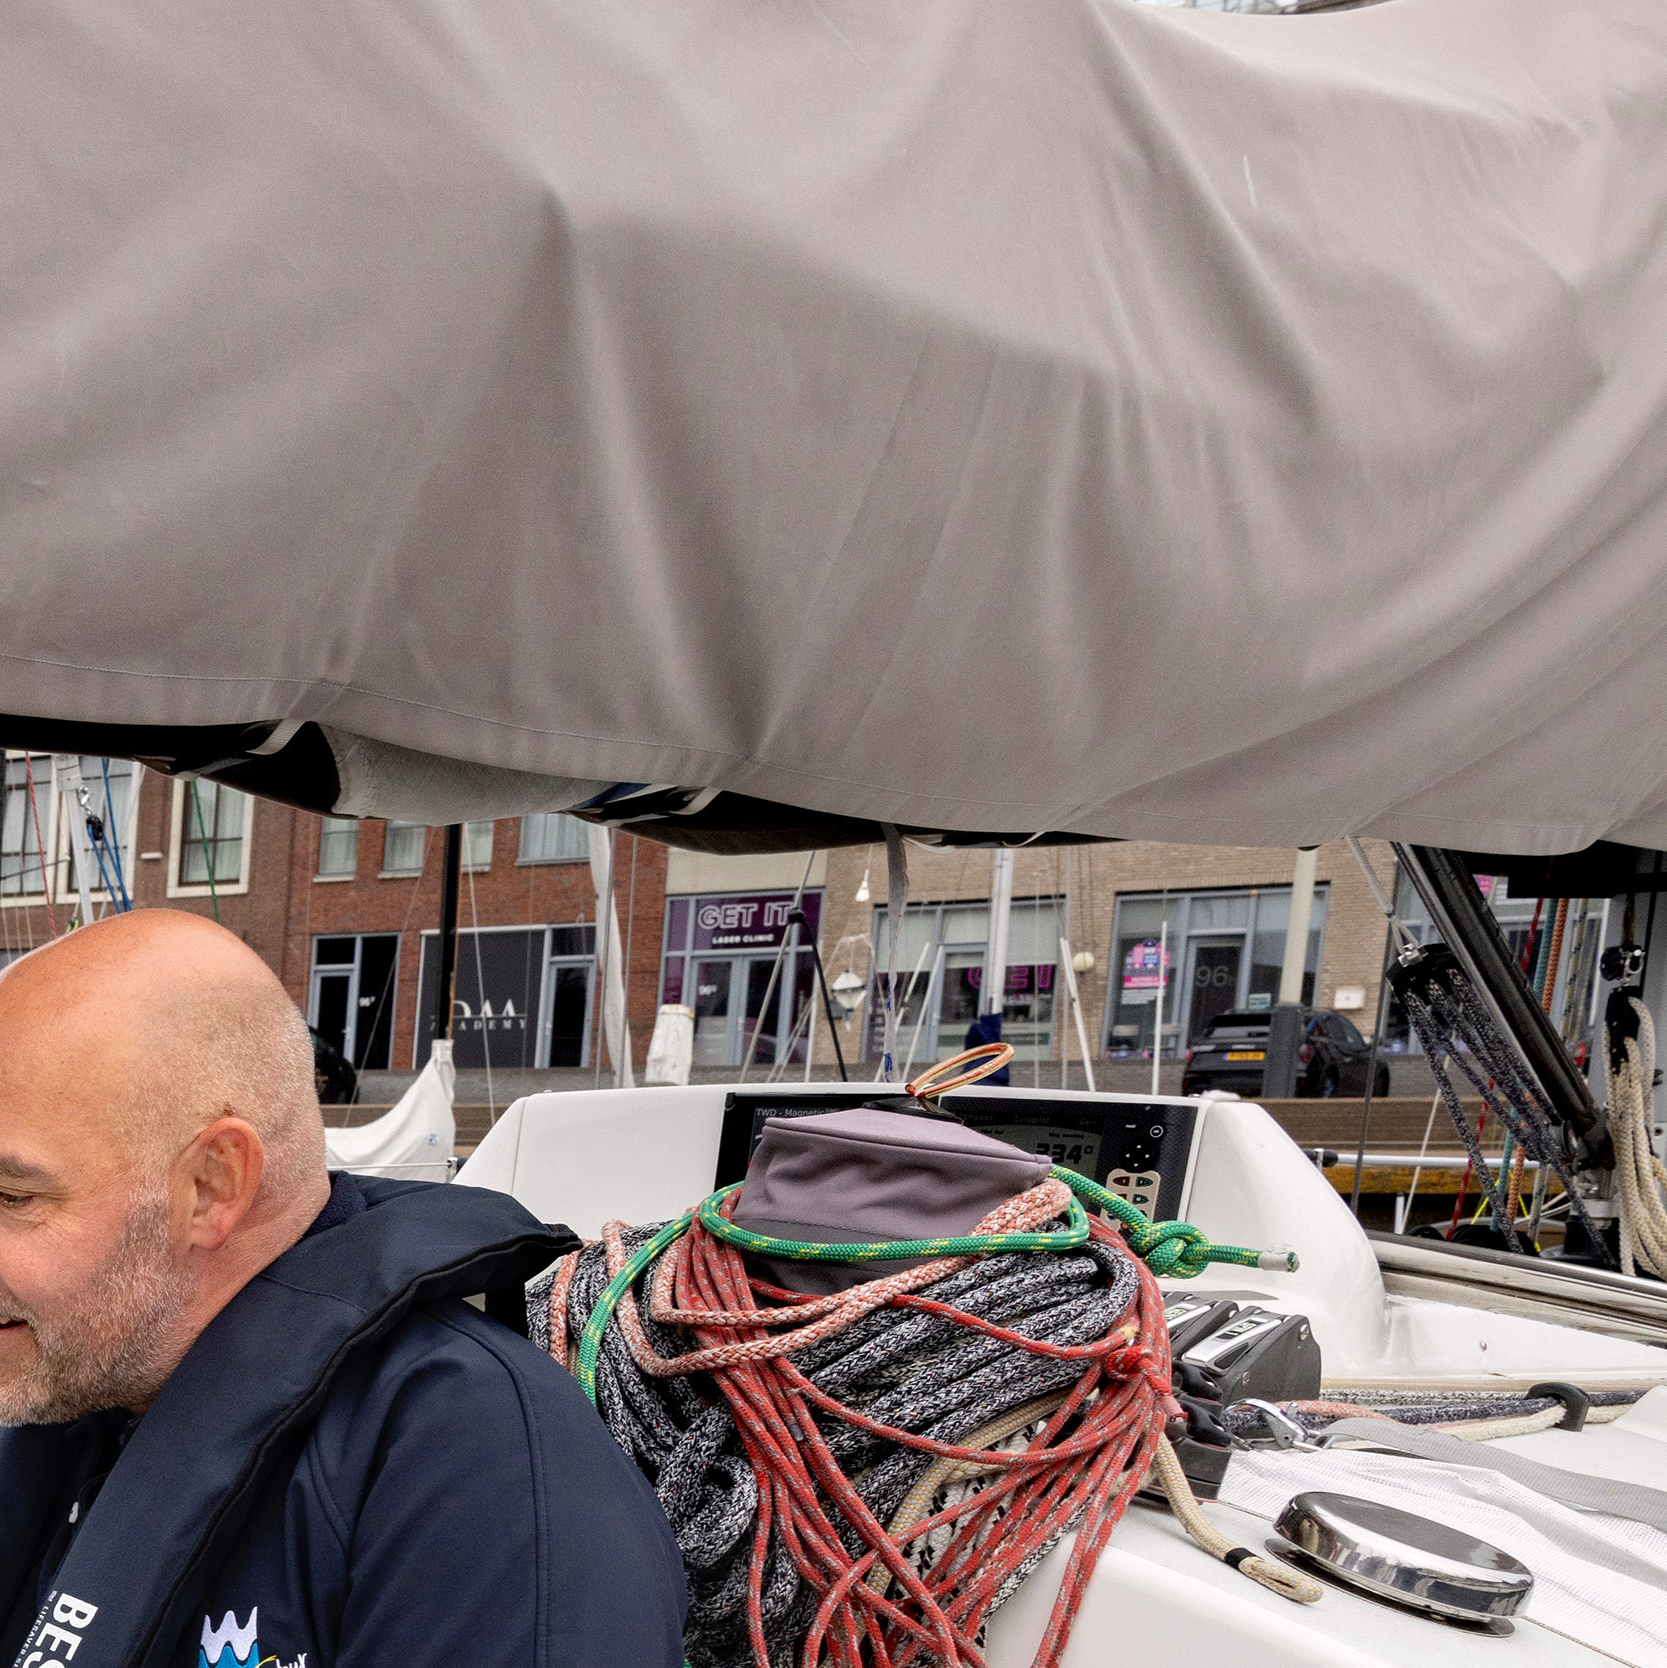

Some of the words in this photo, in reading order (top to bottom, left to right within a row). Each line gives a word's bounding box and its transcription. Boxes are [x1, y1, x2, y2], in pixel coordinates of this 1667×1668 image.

[697, 903, 759, 930] GET
[763, 901, 795, 927] IT
[712, 934, 741, 945] LASER
[430, 1019, 527, 1031] ADEMY
[756, 1108, 777, 1117] TWD
[20, 1605, 50, 1656] LIFESAVER
